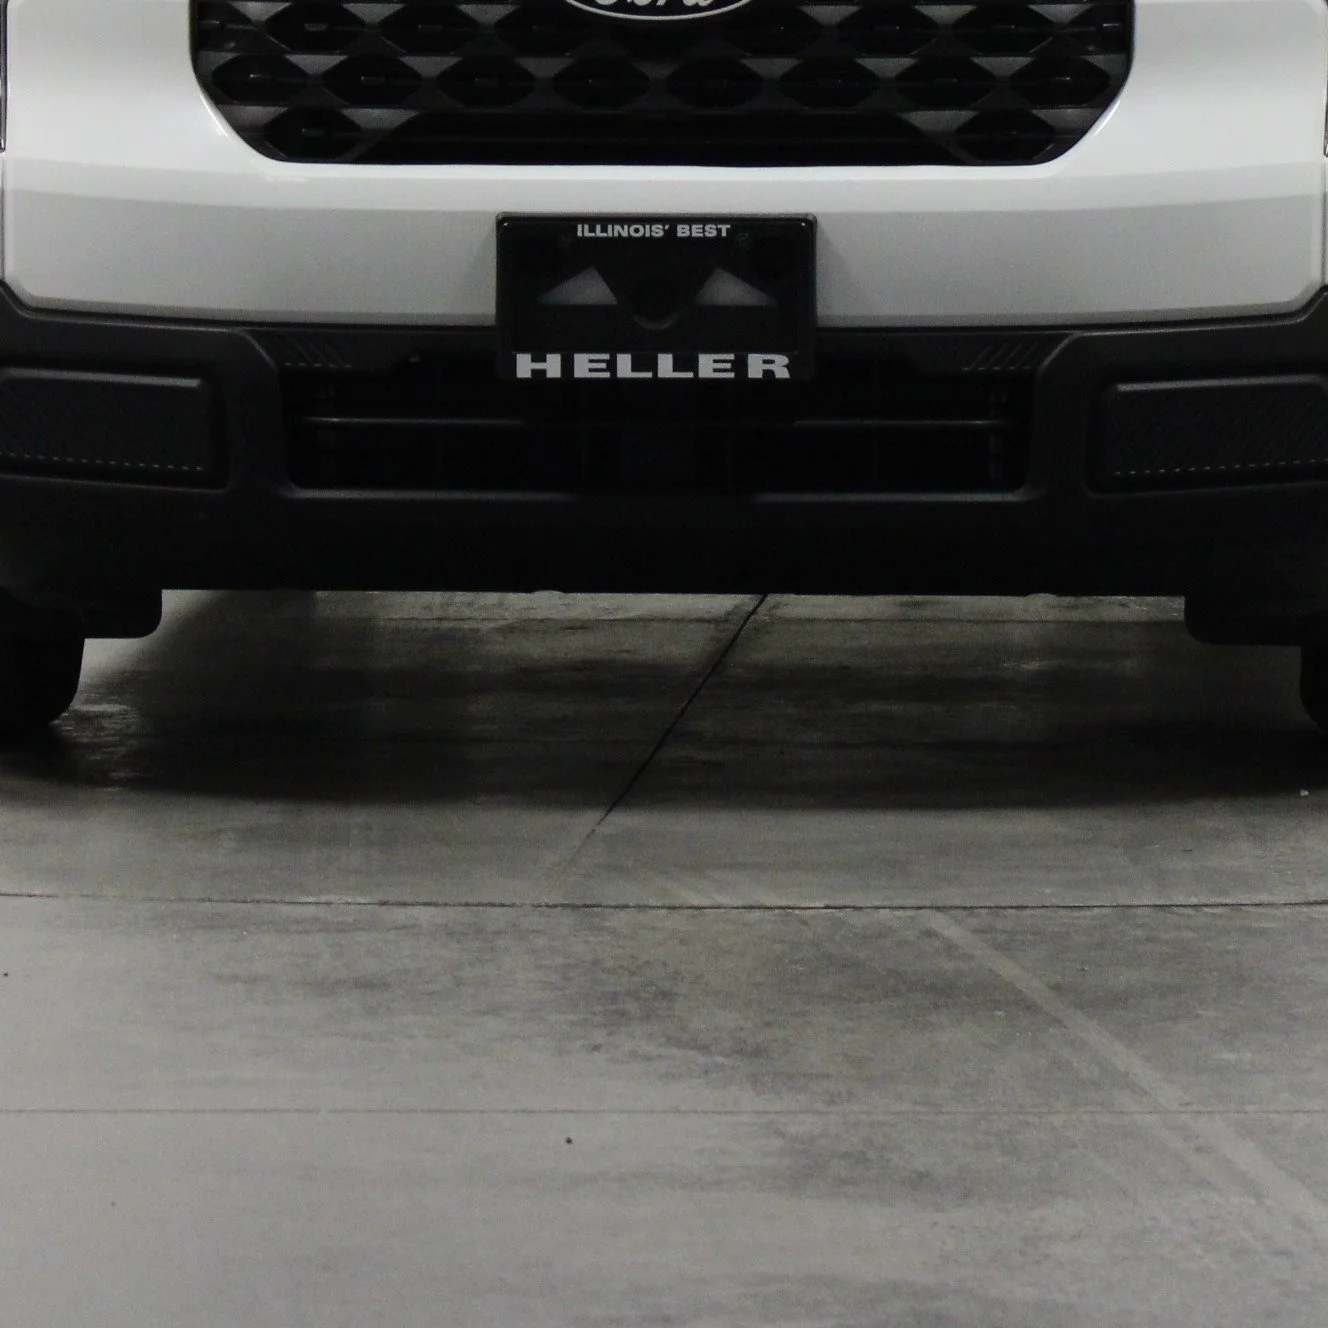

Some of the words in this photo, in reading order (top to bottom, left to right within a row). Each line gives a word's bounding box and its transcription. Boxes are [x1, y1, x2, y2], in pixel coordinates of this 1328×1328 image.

[576, 223, 670, 238] ILLINOIS'
[676, 223, 731, 238] BEST
[515, 352, 791, 379] HELLER
